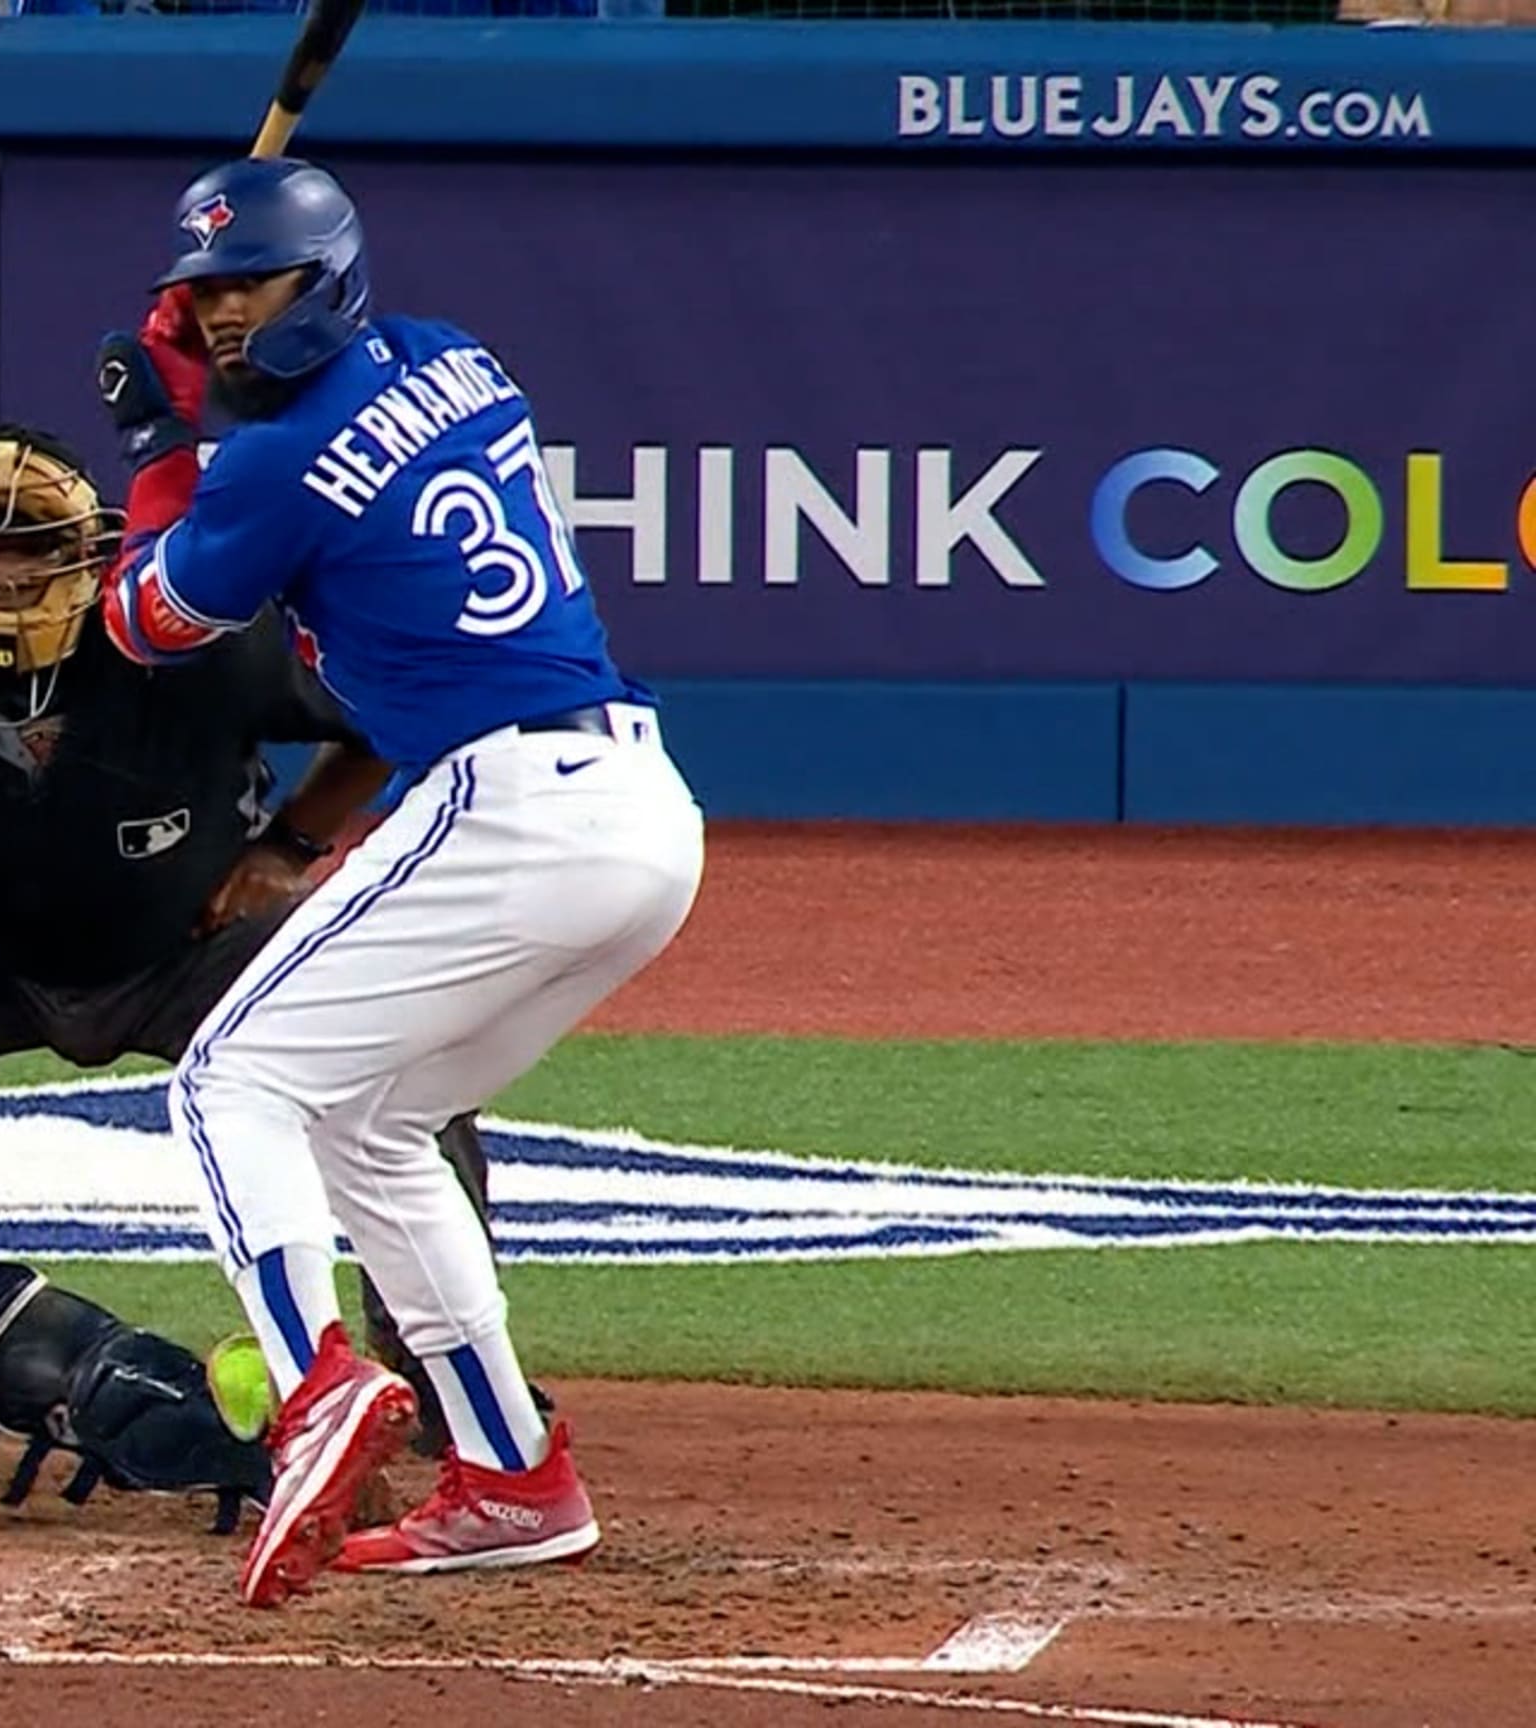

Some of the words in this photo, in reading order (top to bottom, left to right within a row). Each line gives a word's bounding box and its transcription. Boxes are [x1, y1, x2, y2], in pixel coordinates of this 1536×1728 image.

[302, 346, 524, 518] HERNÁNDE
[539, 446, 1046, 586] HINK
[1090, 448, 1536, 590] COL
[411, 416, 585, 636] 37
